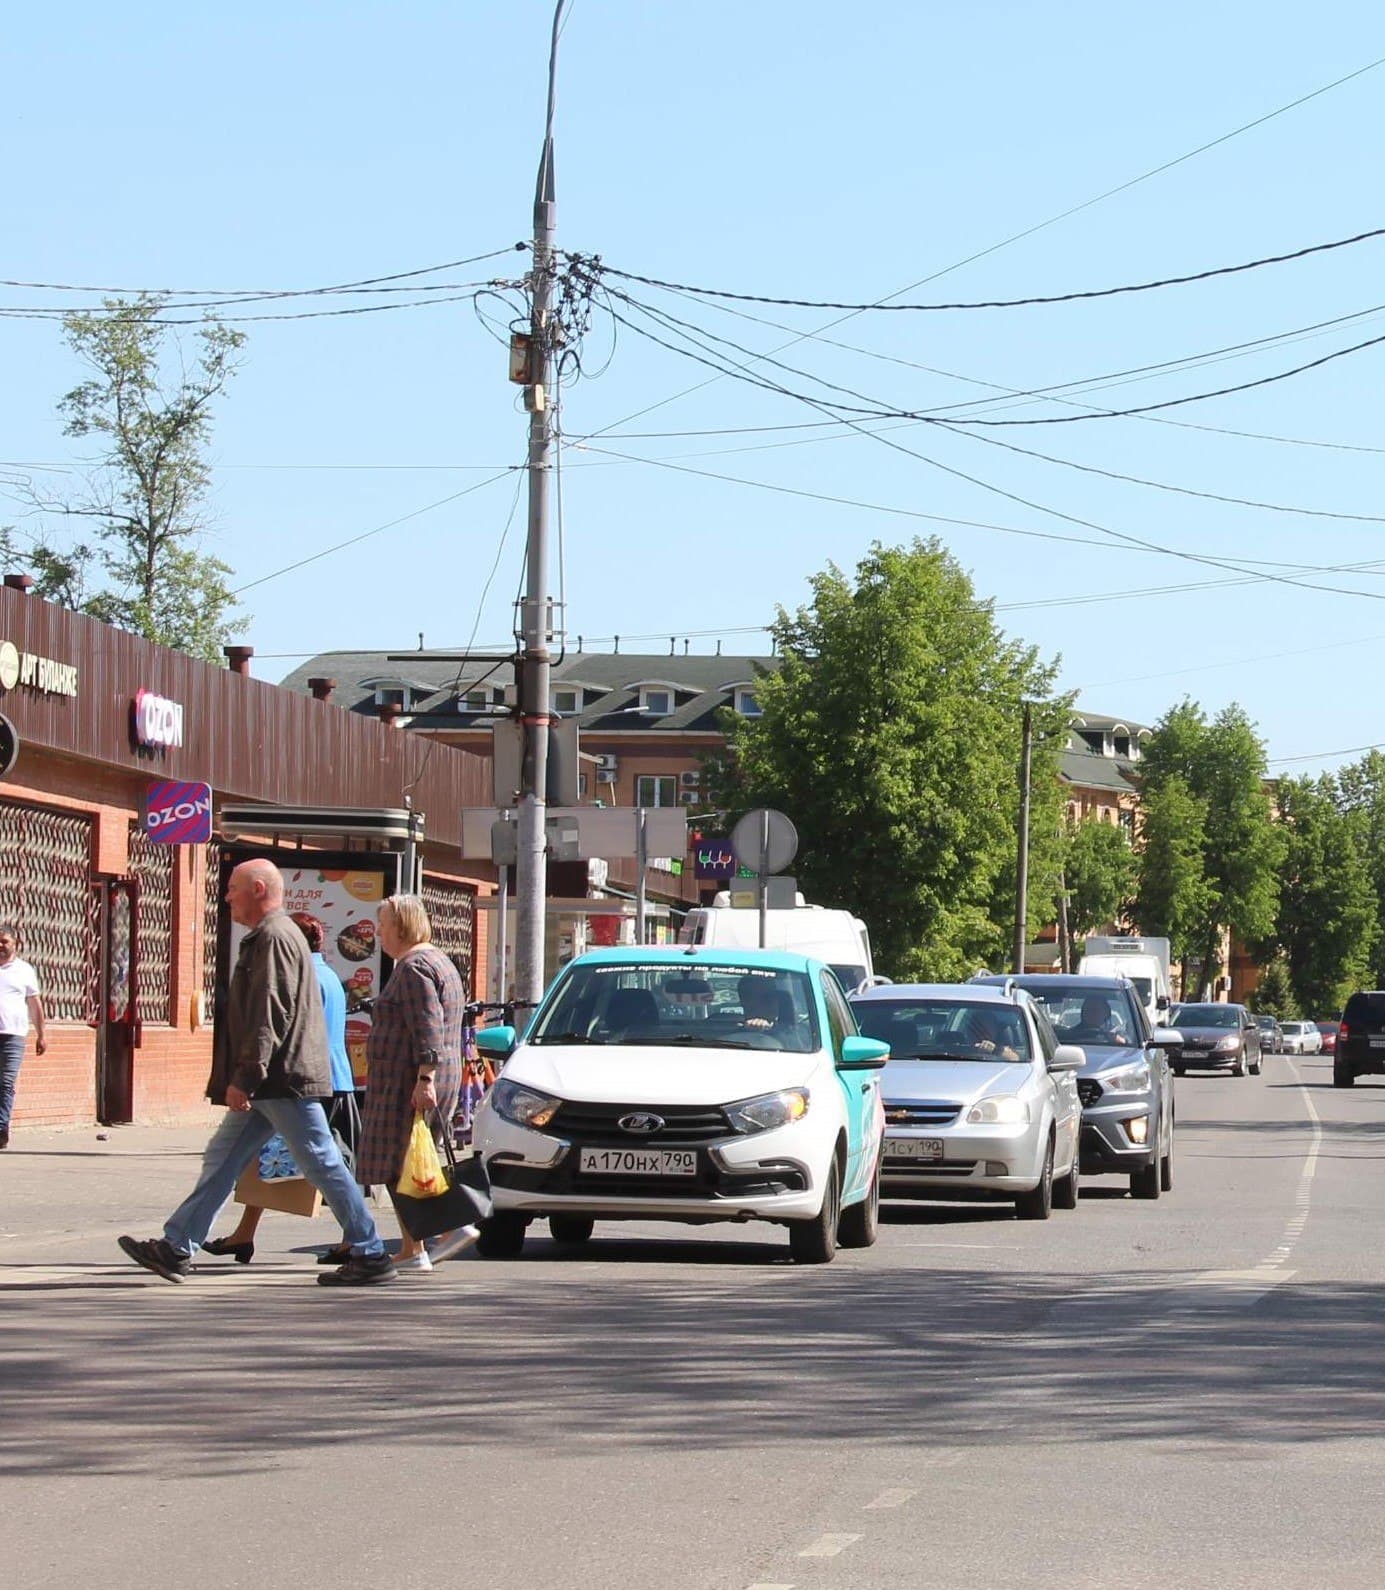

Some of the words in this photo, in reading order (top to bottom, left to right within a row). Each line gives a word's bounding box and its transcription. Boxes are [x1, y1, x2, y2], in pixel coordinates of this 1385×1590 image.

[20, 652, 38, 687] АРТ
[38, 656, 77, 697] БУЛАНЖЕ
[143, 693, 183, 748] OZON
[147, 798, 211, 828] OZON
[638, 965, 691, 973] продукты
[711, 967, 749, 975] любой
[751, 969, 777, 977] вкус
[586, 1152, 659, 1171] А170НХ
[663, 1152, 693, 1167] 790
